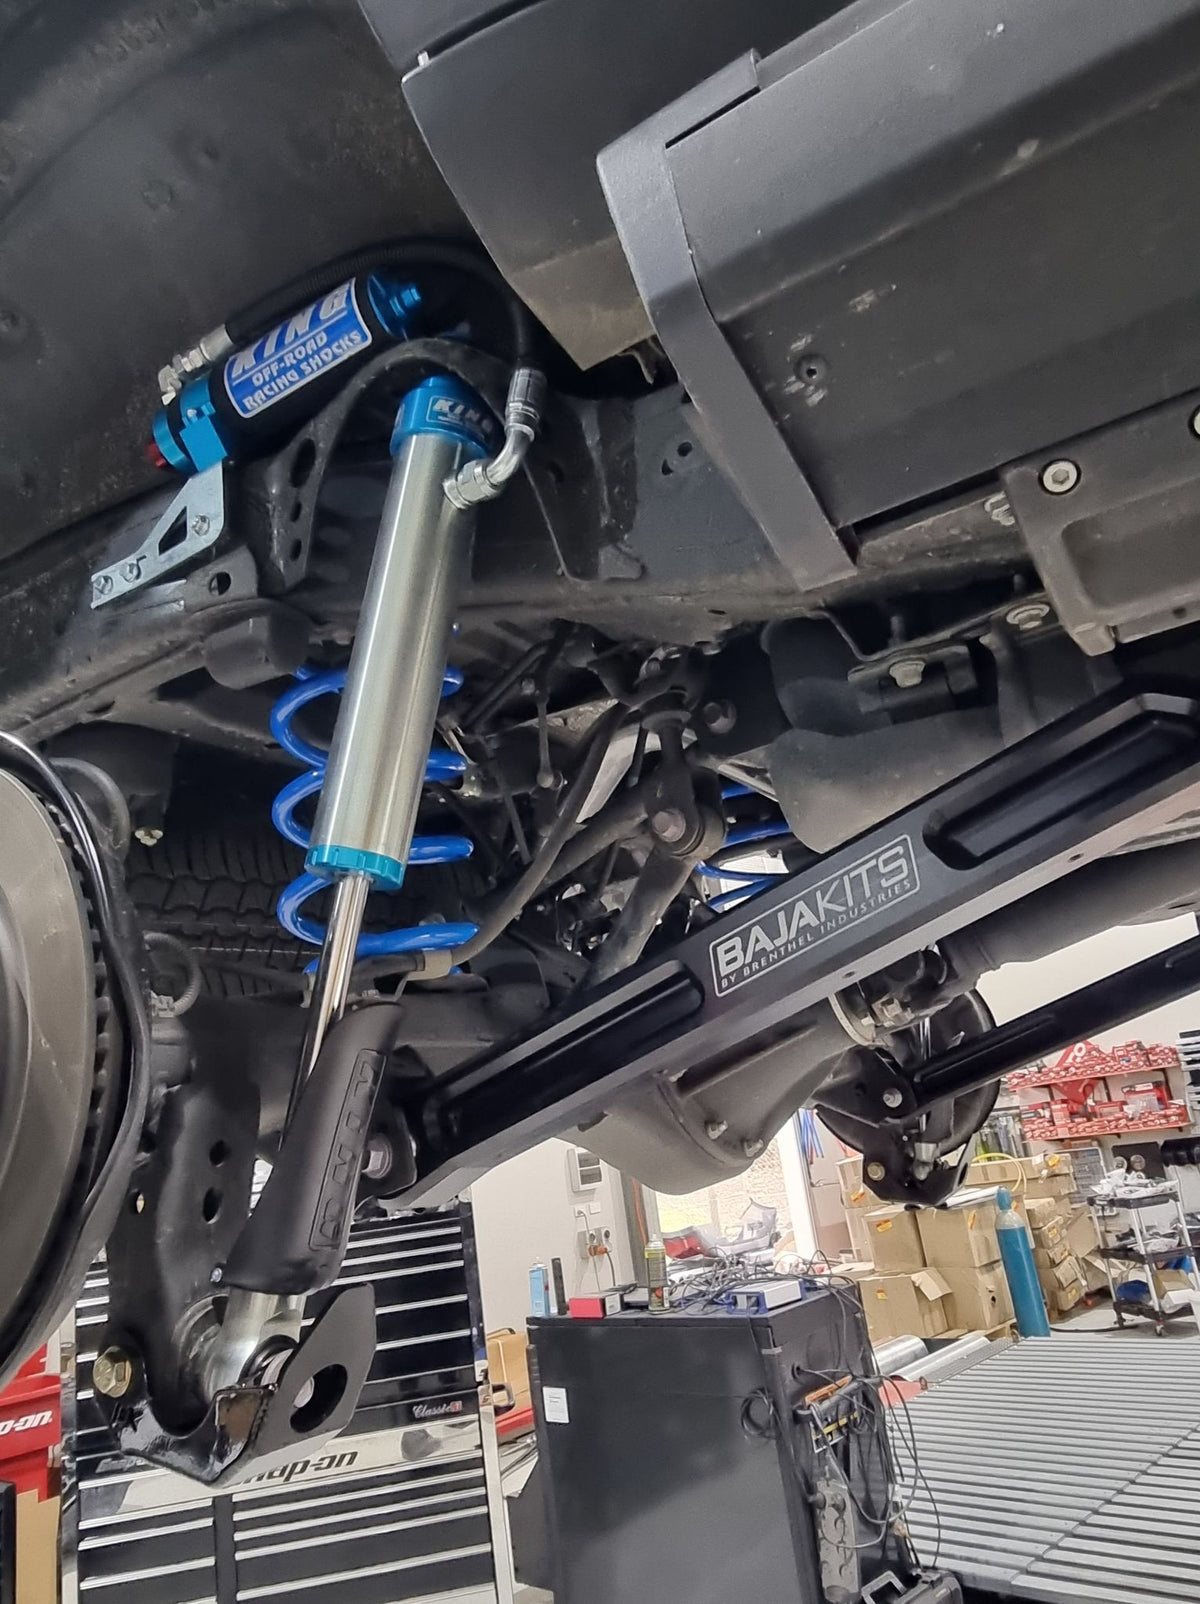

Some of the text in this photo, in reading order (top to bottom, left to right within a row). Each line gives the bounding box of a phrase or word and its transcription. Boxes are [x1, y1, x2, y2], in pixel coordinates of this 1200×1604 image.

[242, 330, 362, 411] RACING SHOCKS
[251, 330, 328, 387] OFF-ROAD
[716, 845, 909, 977] BAJAKITS
[721, 879, 911, 989] BY BRENTHEL INDUSTRIES
